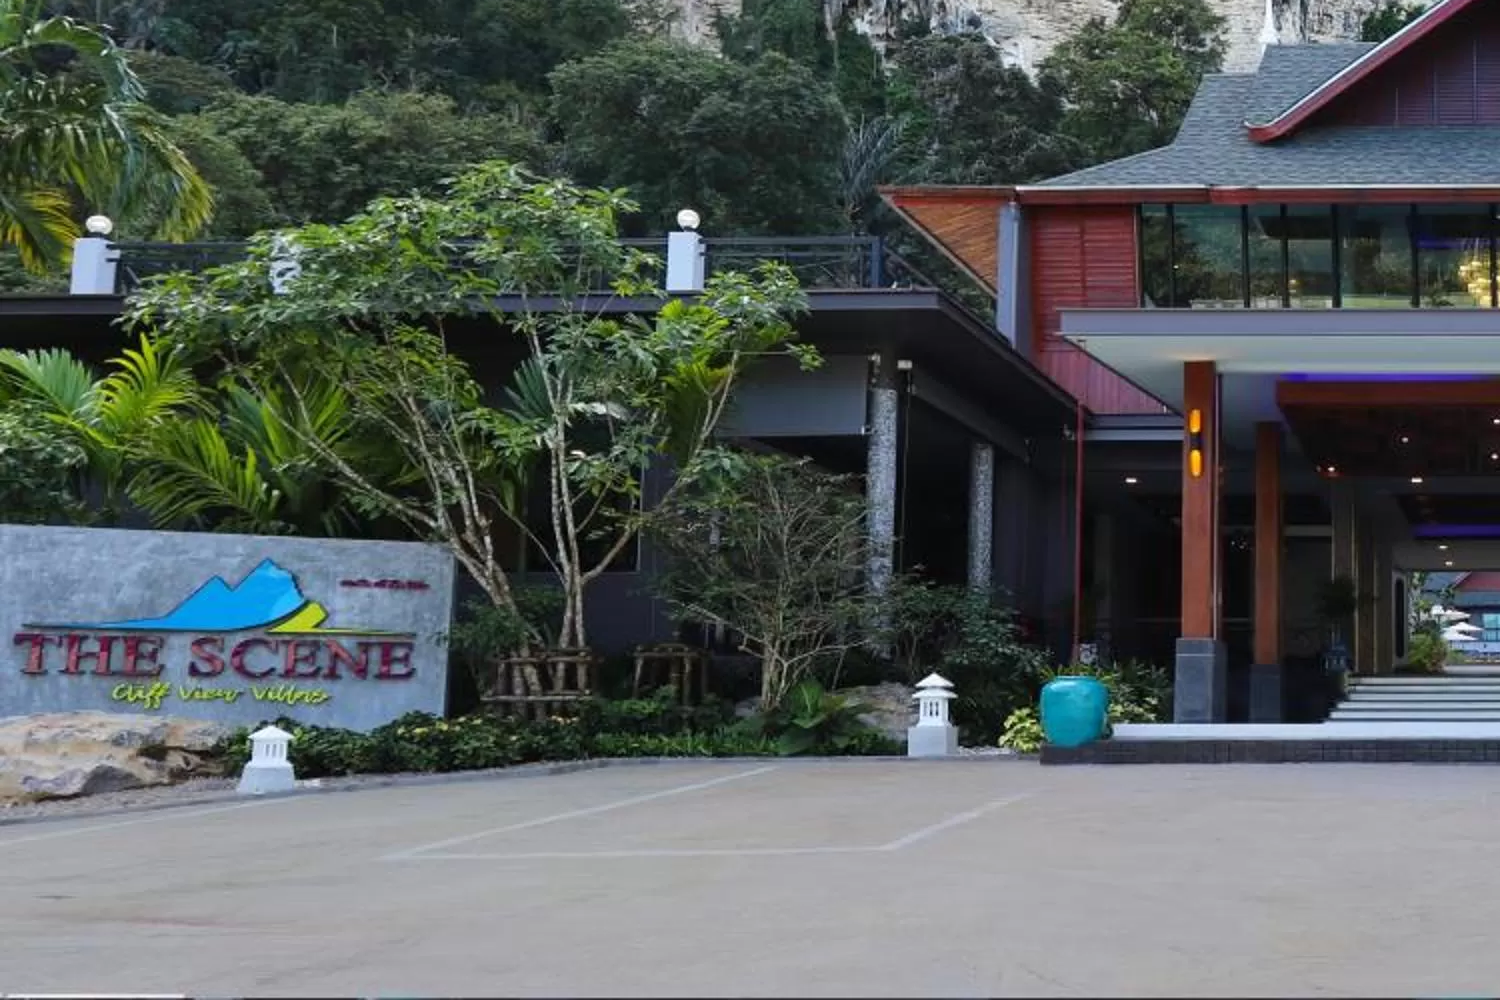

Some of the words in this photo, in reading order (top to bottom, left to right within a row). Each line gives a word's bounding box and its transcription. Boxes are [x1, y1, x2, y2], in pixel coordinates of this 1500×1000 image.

[14, 633, 165, 676] THE
[188, 637, 417, 679] SCENE
[111, 682, 170, 709] Cliff
[178, 685, 243, 704] View
